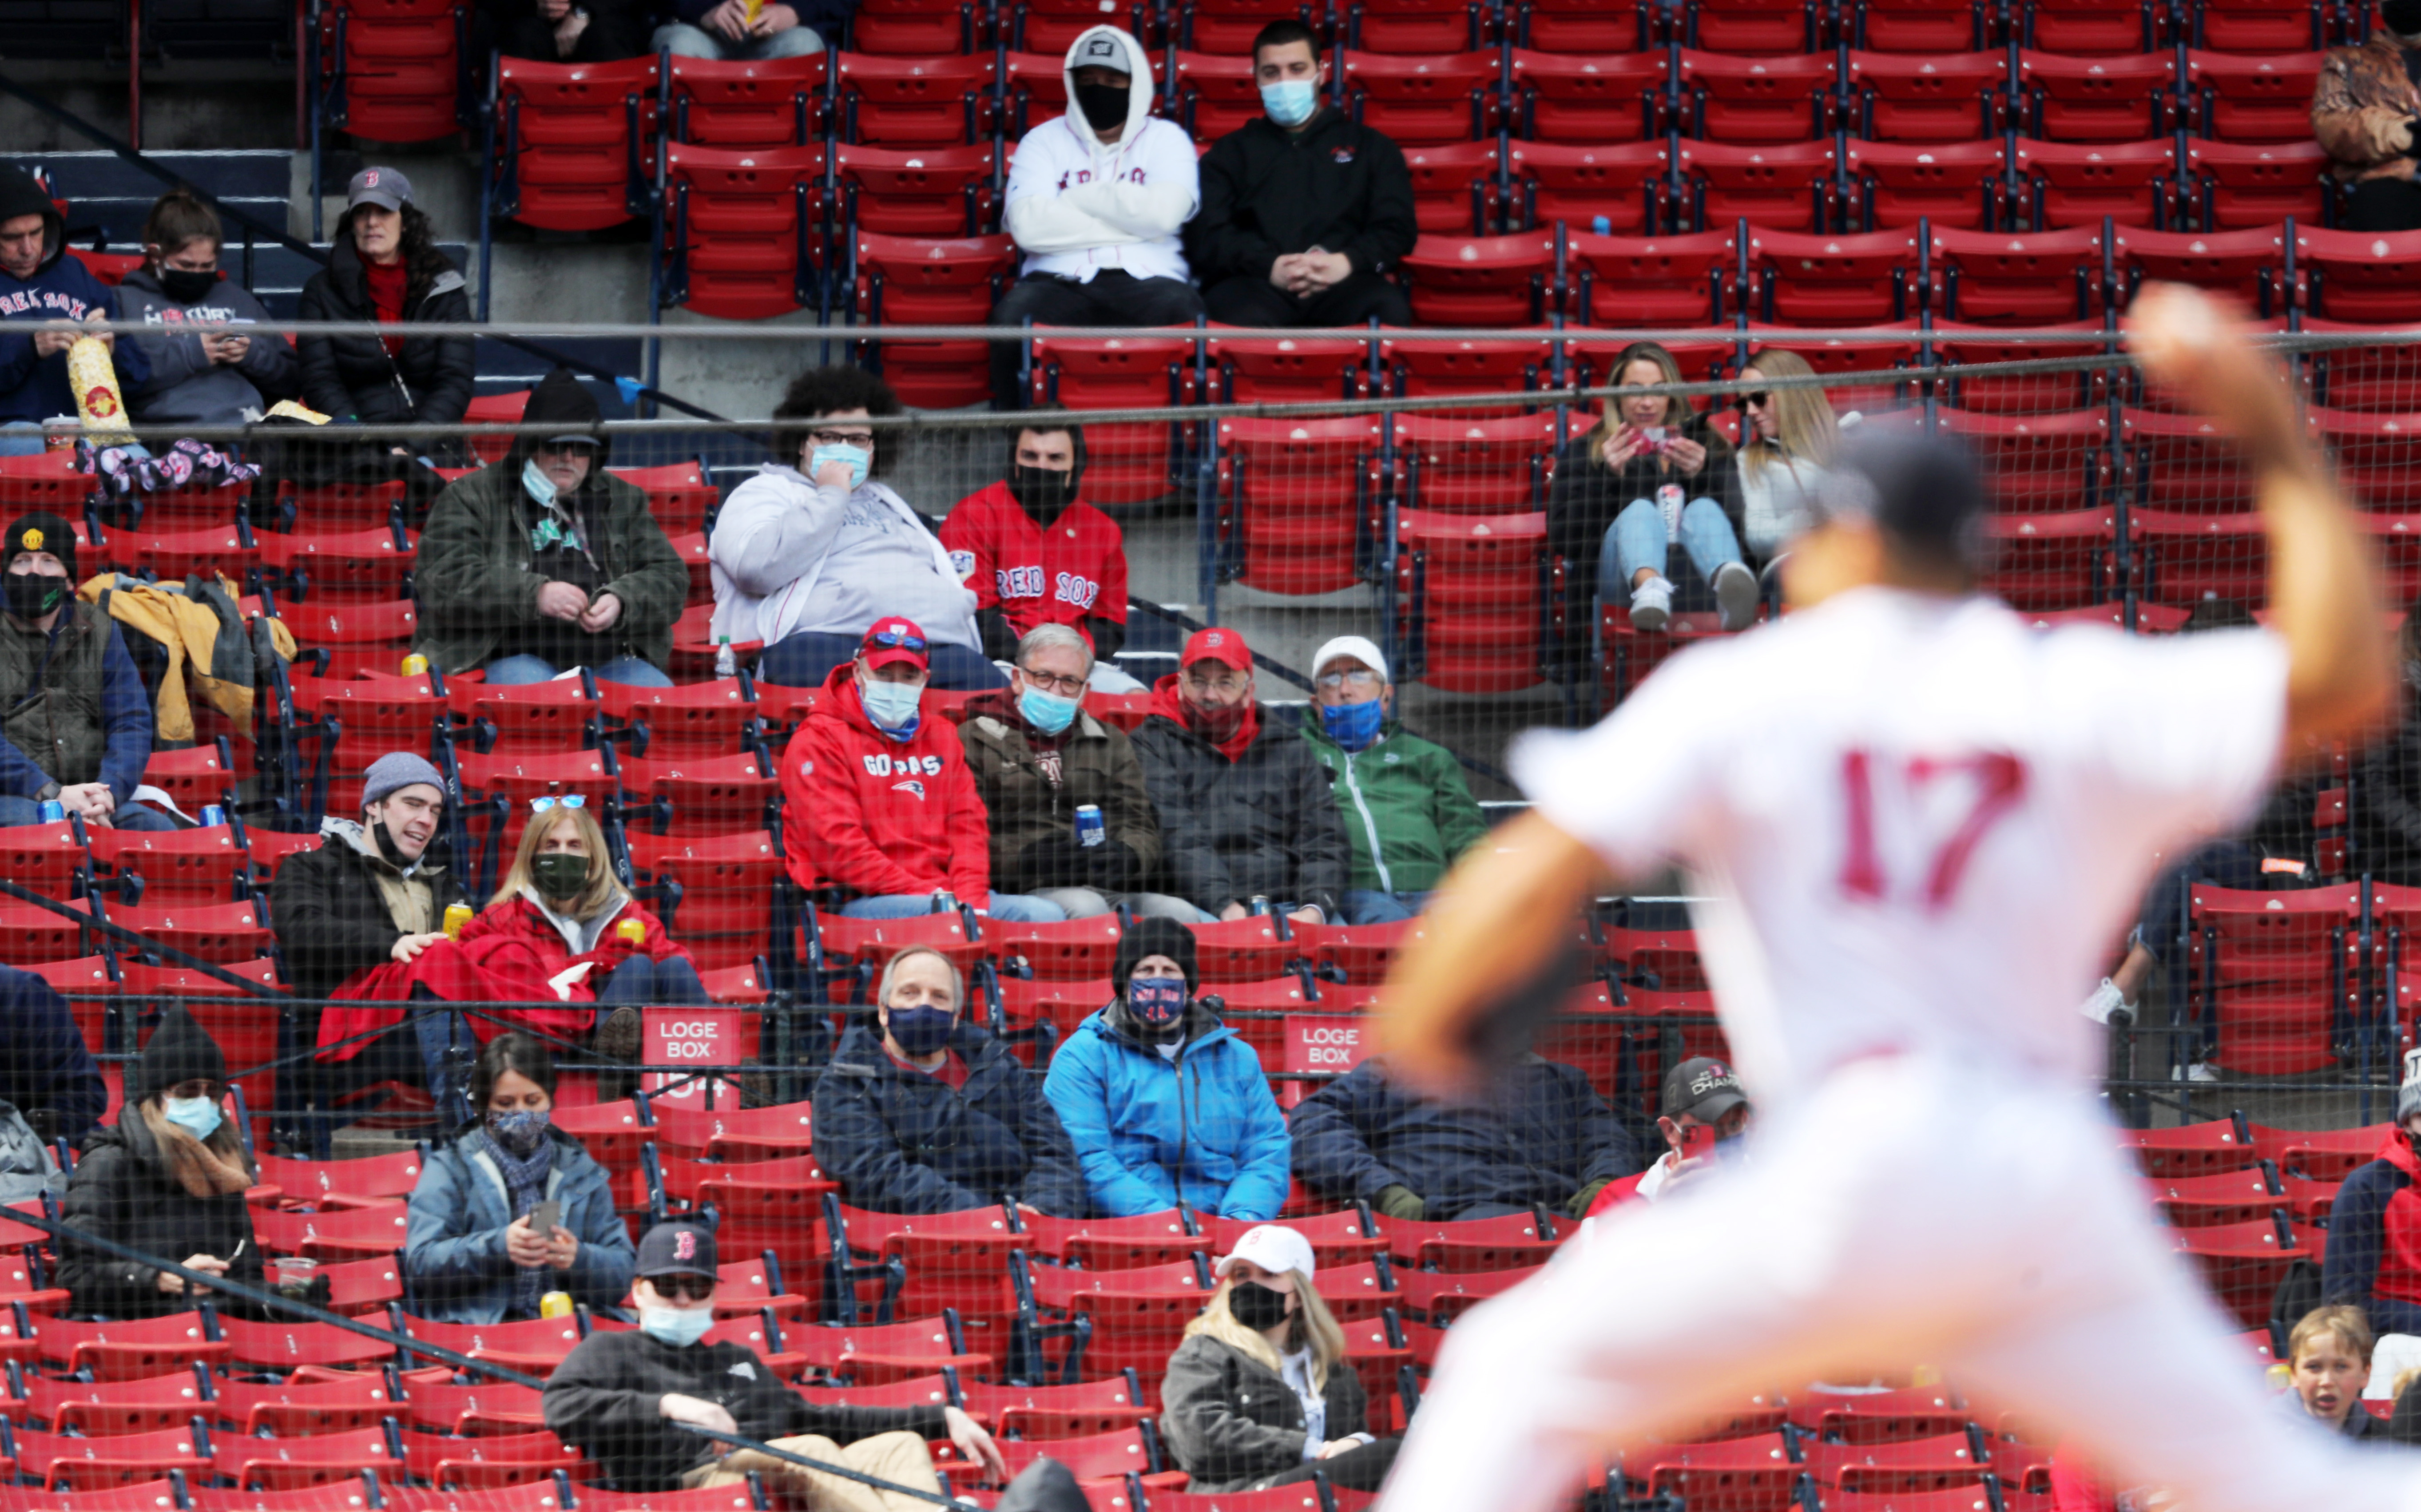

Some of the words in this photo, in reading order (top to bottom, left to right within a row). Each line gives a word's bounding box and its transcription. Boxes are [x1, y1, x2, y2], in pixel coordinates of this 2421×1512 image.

[996, 566, 1045, 598] RED
[863, 753, 891, 777] GO
[1838, 746, 2028, 916] 17
[660, 1022, 718, 1038] LOGE
[1302, 1028, 1359, 1044] LOGE
[667, 1041, 710, 1058] BOX
[1309, 1048, 1350, 1064] BOX
[673, 1231, 697, 1260] B
